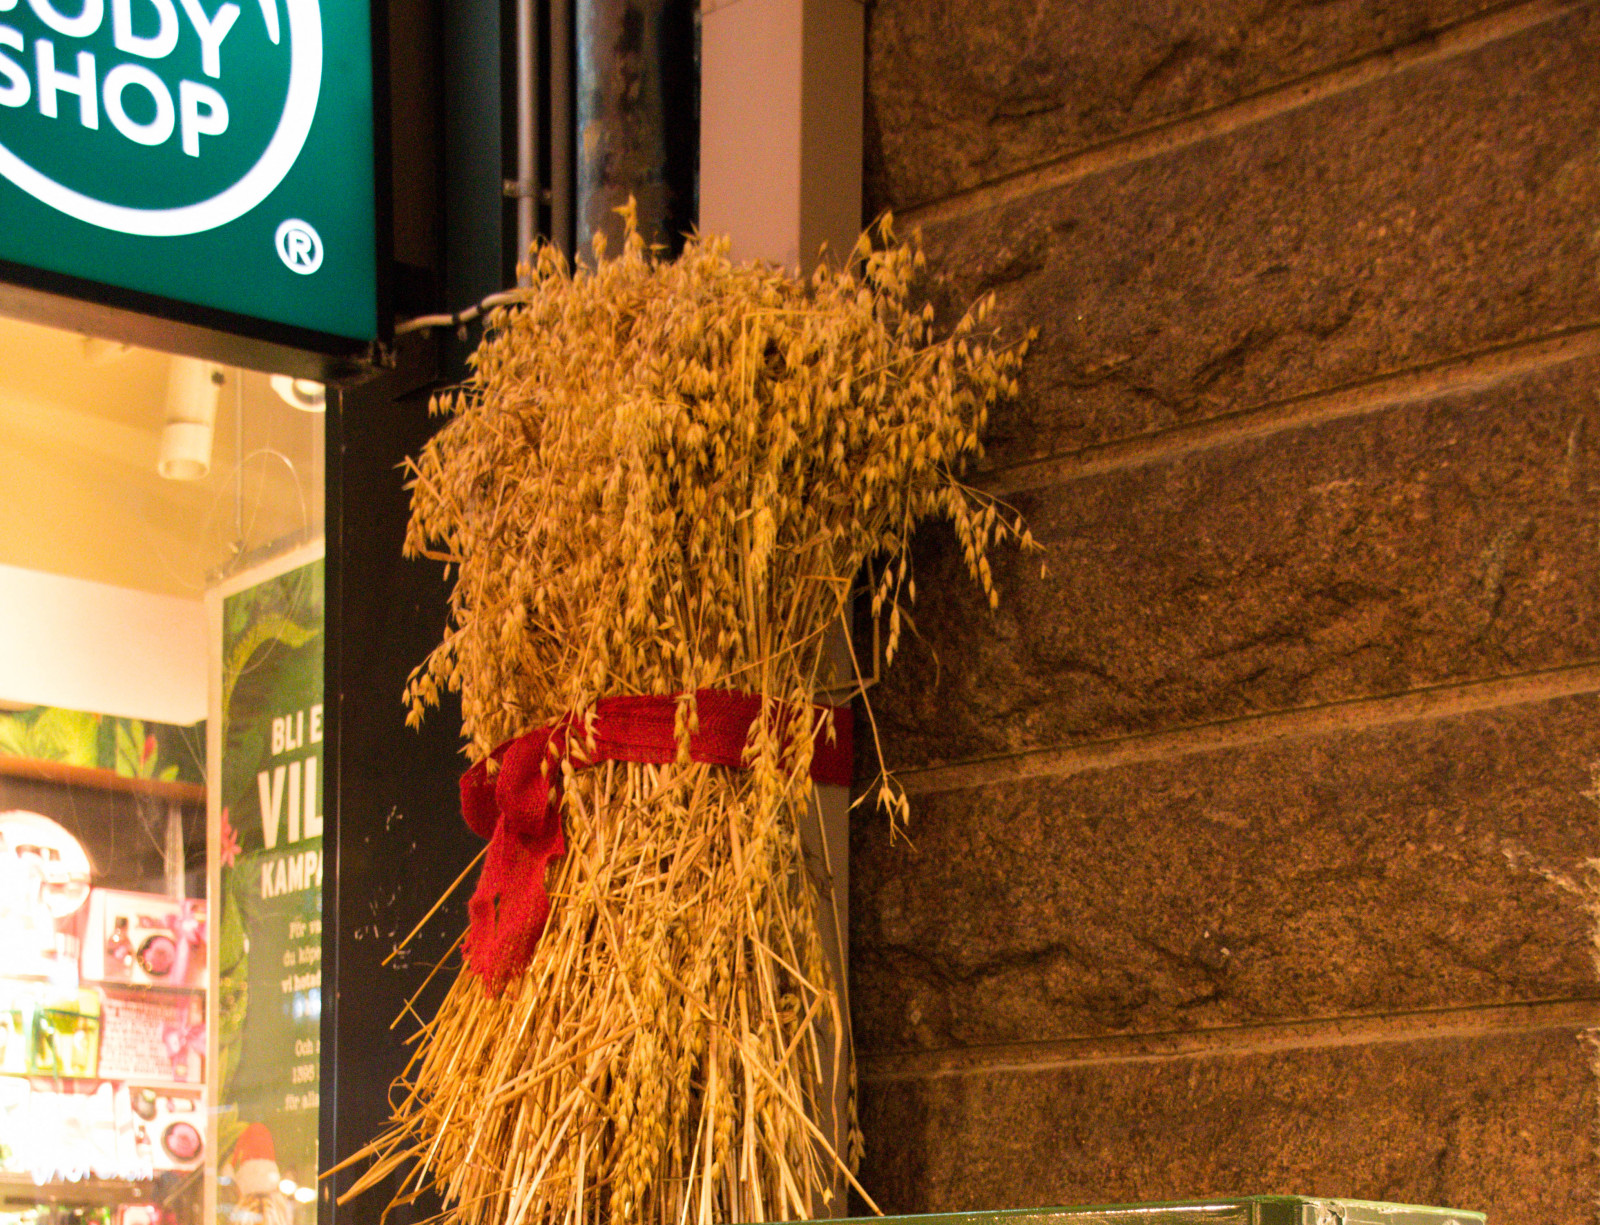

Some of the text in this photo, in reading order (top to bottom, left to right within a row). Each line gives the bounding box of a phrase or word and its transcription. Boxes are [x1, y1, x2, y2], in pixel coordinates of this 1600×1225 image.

[0, 0, 241, 79] DY
[0, 24, 230, 158] SHOP
[271, 710, 304, 756] BLI
[257, 756, 323, 850] VIL
